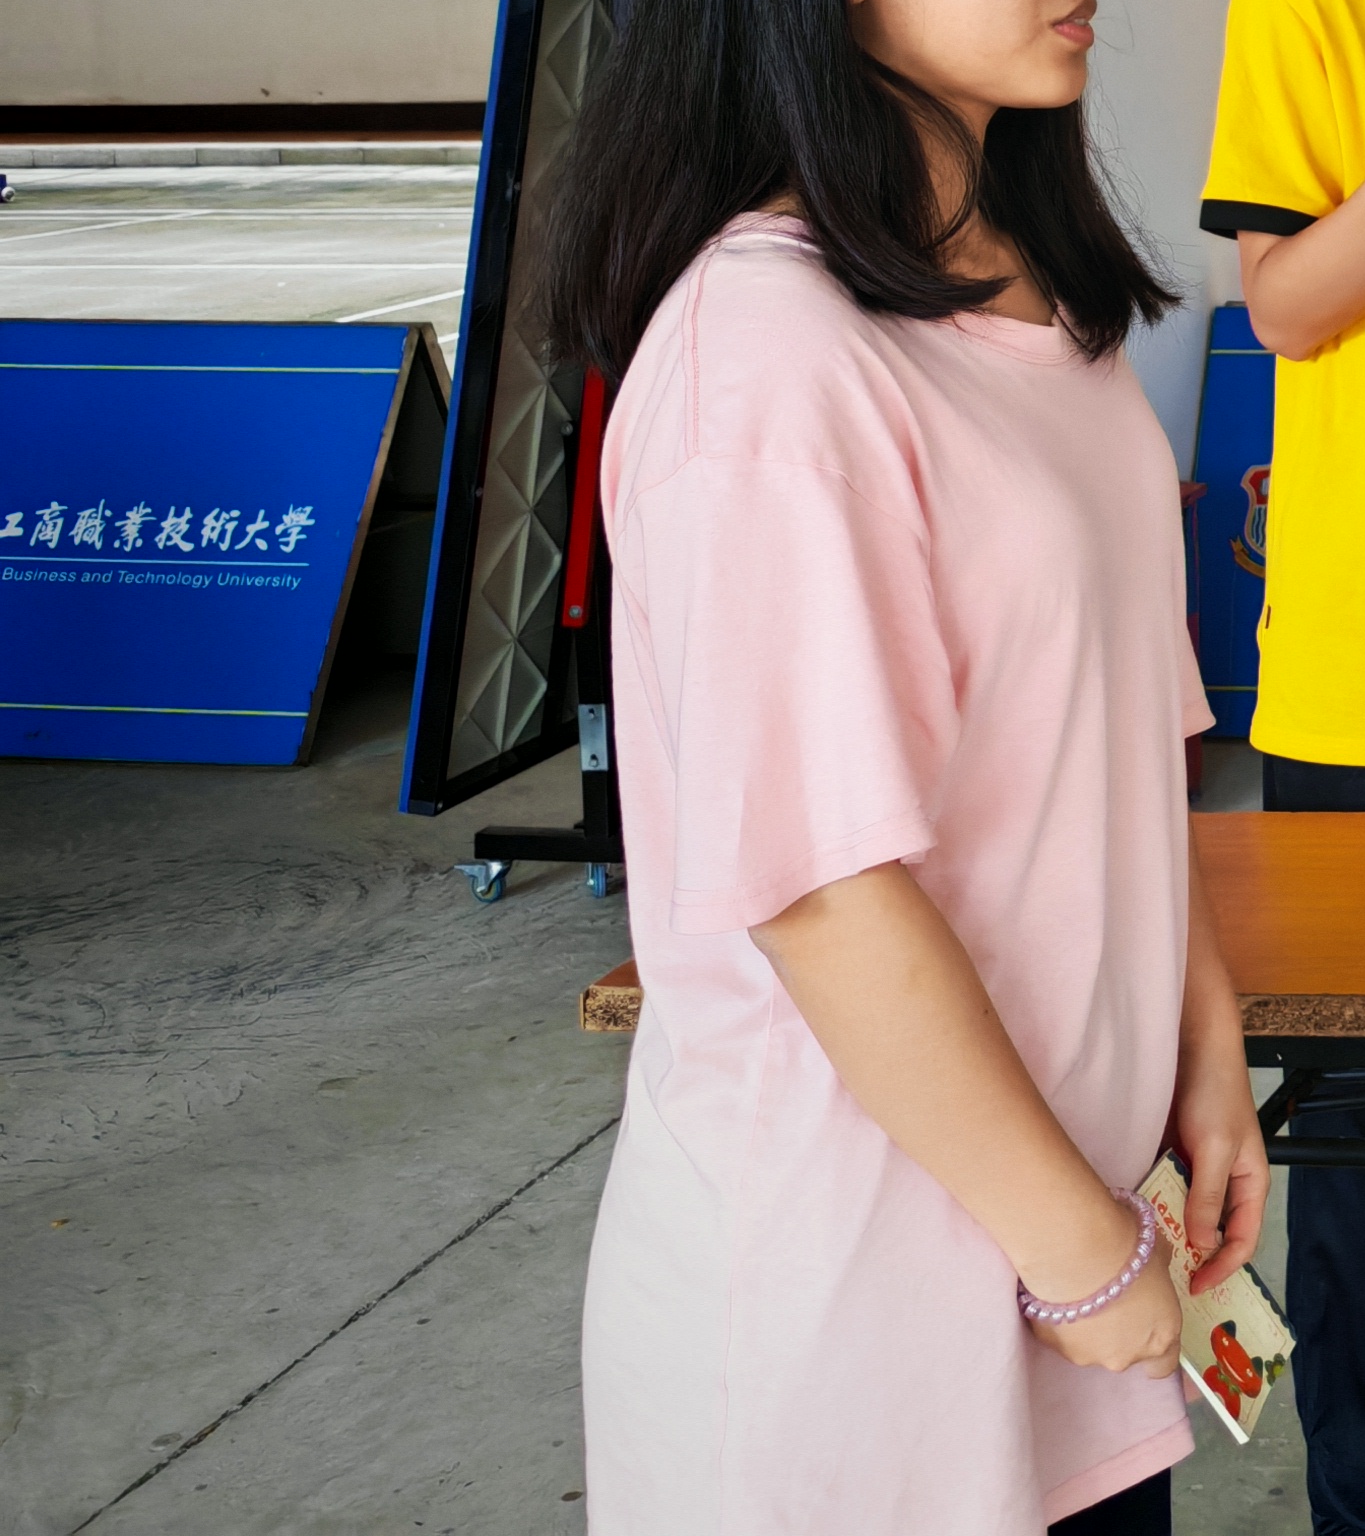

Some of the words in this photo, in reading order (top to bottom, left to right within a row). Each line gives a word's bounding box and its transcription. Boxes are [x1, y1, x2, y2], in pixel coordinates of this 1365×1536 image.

[1, 567, 77, 582] Business
[80, 569, 113, 583] and
[117, 570, 213, 588] Technology
[217, 572, 302, 590] University
